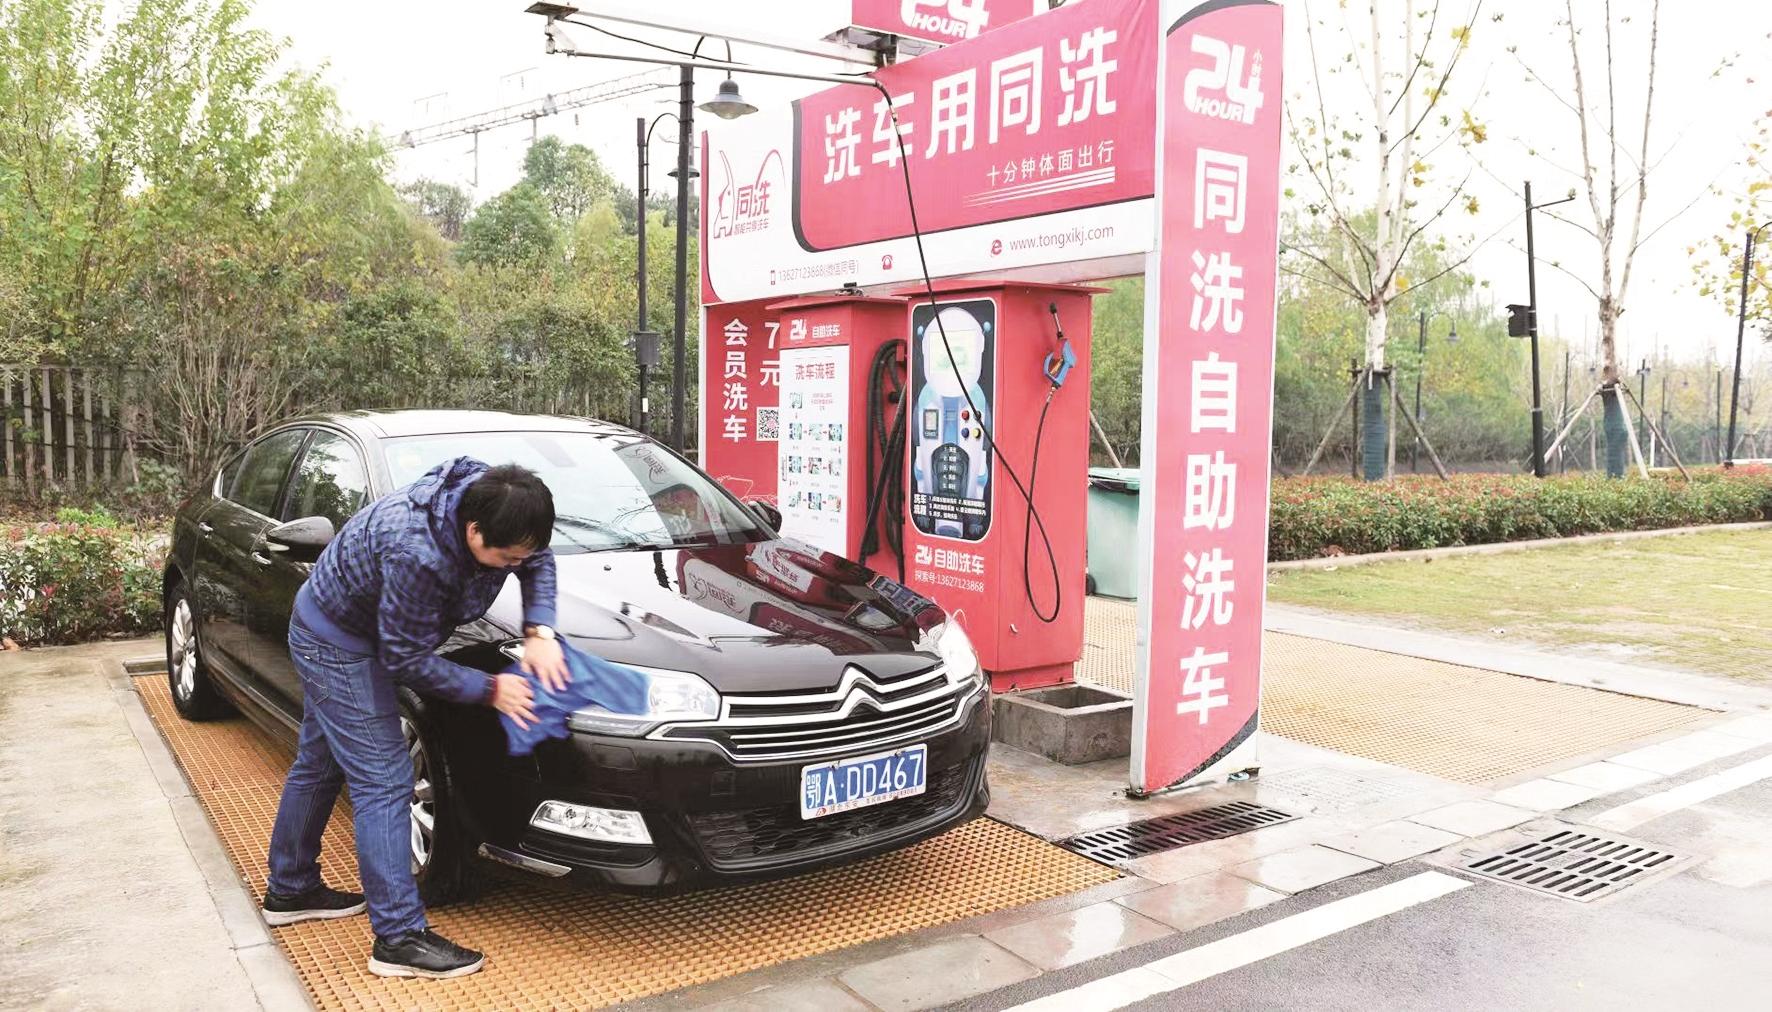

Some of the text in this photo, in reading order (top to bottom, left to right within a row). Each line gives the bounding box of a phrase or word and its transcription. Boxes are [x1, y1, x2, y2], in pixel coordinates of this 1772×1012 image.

[911, 12, 967, 38] HOUR
[1183, 32, 1264, 124] 24
[823, 26, 1118, 185] 洗车用同洗
[1194, 96, 1244, 122] HOUR
[987, 140, 1115, 187] 十分钟体面出行
[735, 180, 772, 221] 同洗
[1009, 226, 1114, 251] www.tongxikj.com
[789, 318, 841, 340] 24 自助洗车
[722, 318, 749, 443] 会员洗车
[795, 362, 836, 380] 洗车流程
[1176, 147, 1249, 725] 同洗自助洗车
[915, 544, 985, 575] 24 自助洗车
